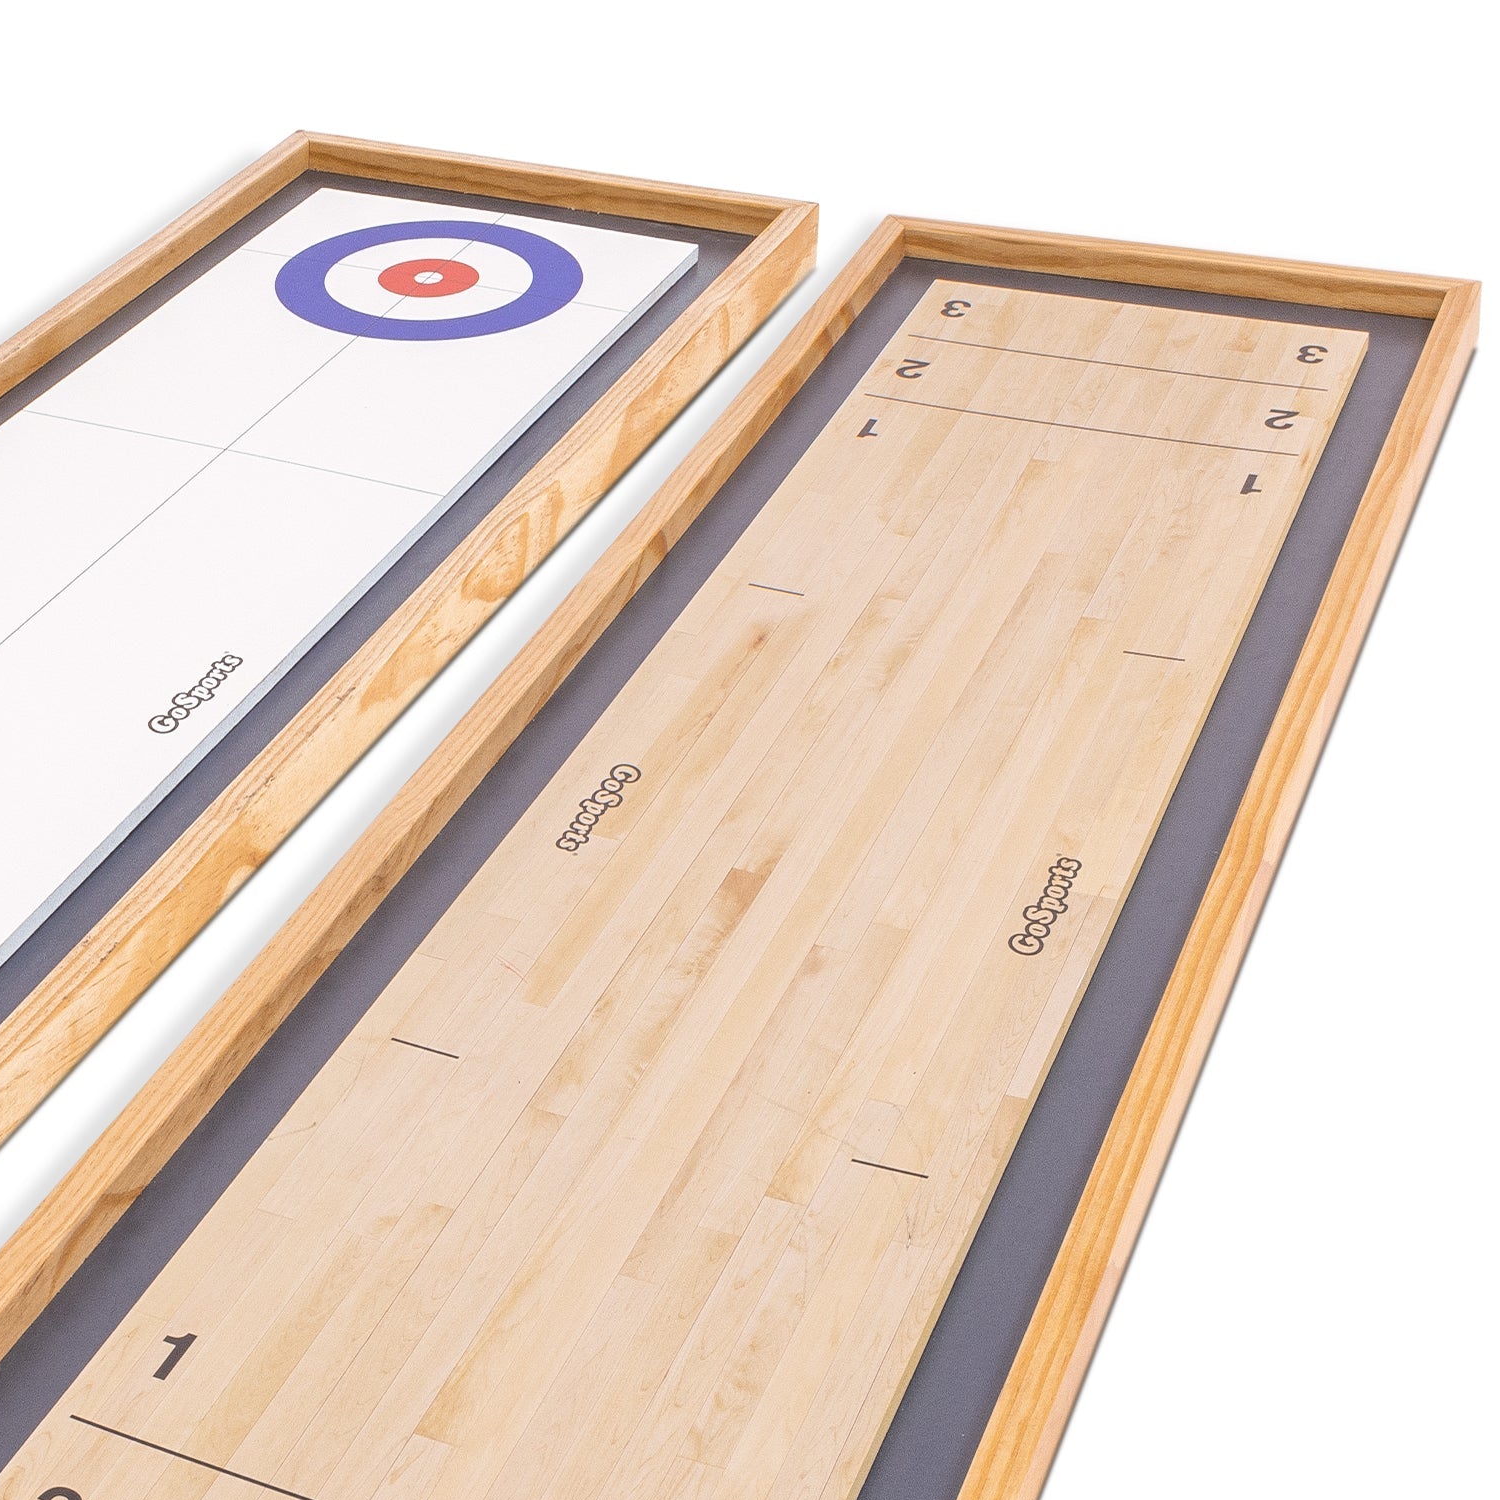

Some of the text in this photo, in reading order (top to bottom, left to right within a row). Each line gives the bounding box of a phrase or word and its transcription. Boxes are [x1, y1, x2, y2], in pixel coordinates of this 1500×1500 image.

[940, 300, 972, 318] 3
[1296, 345, 1328, 364] 3
[895, 358, 931, 379] 2
[856, 418, 878, 438] 1
[1264, 409, 1300, 430] 2
[1240, 474, 1262, 495] 1
[147, 653, 244, 734] GoSports
[555, 763, 642, 853] GoSports
[1007, 856, 1082, 956] GoSports
[152, 1332, 198, 1381] 1
